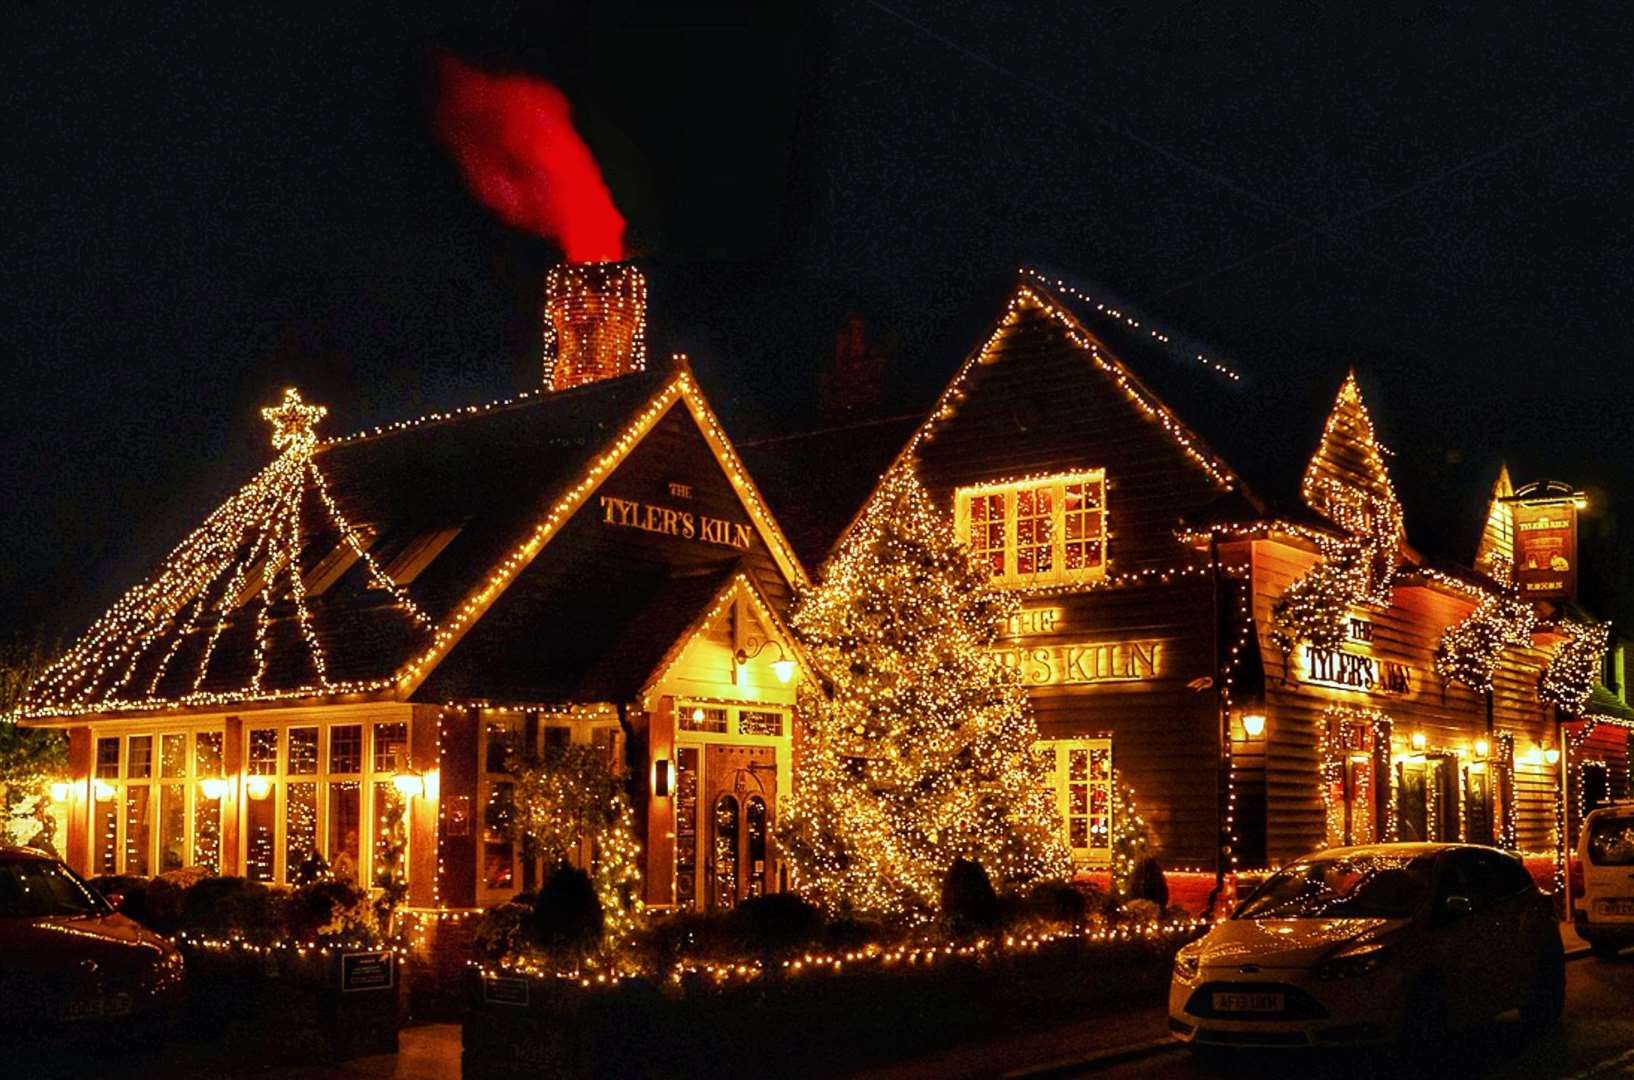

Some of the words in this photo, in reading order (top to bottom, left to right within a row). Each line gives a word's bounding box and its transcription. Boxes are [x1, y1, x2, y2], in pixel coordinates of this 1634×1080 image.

[668, 483, 693, 498] THE
[600, 496, 695, 539] TYLER'S
[700, 516, 752, 548] KILN
[1003, 608, 1058, 634] THE
[1349, 617, 1374, 641] THE
[1064, 643, 1160, 682] KILN
[1305, 645, 1374, 690] TYLER'S
